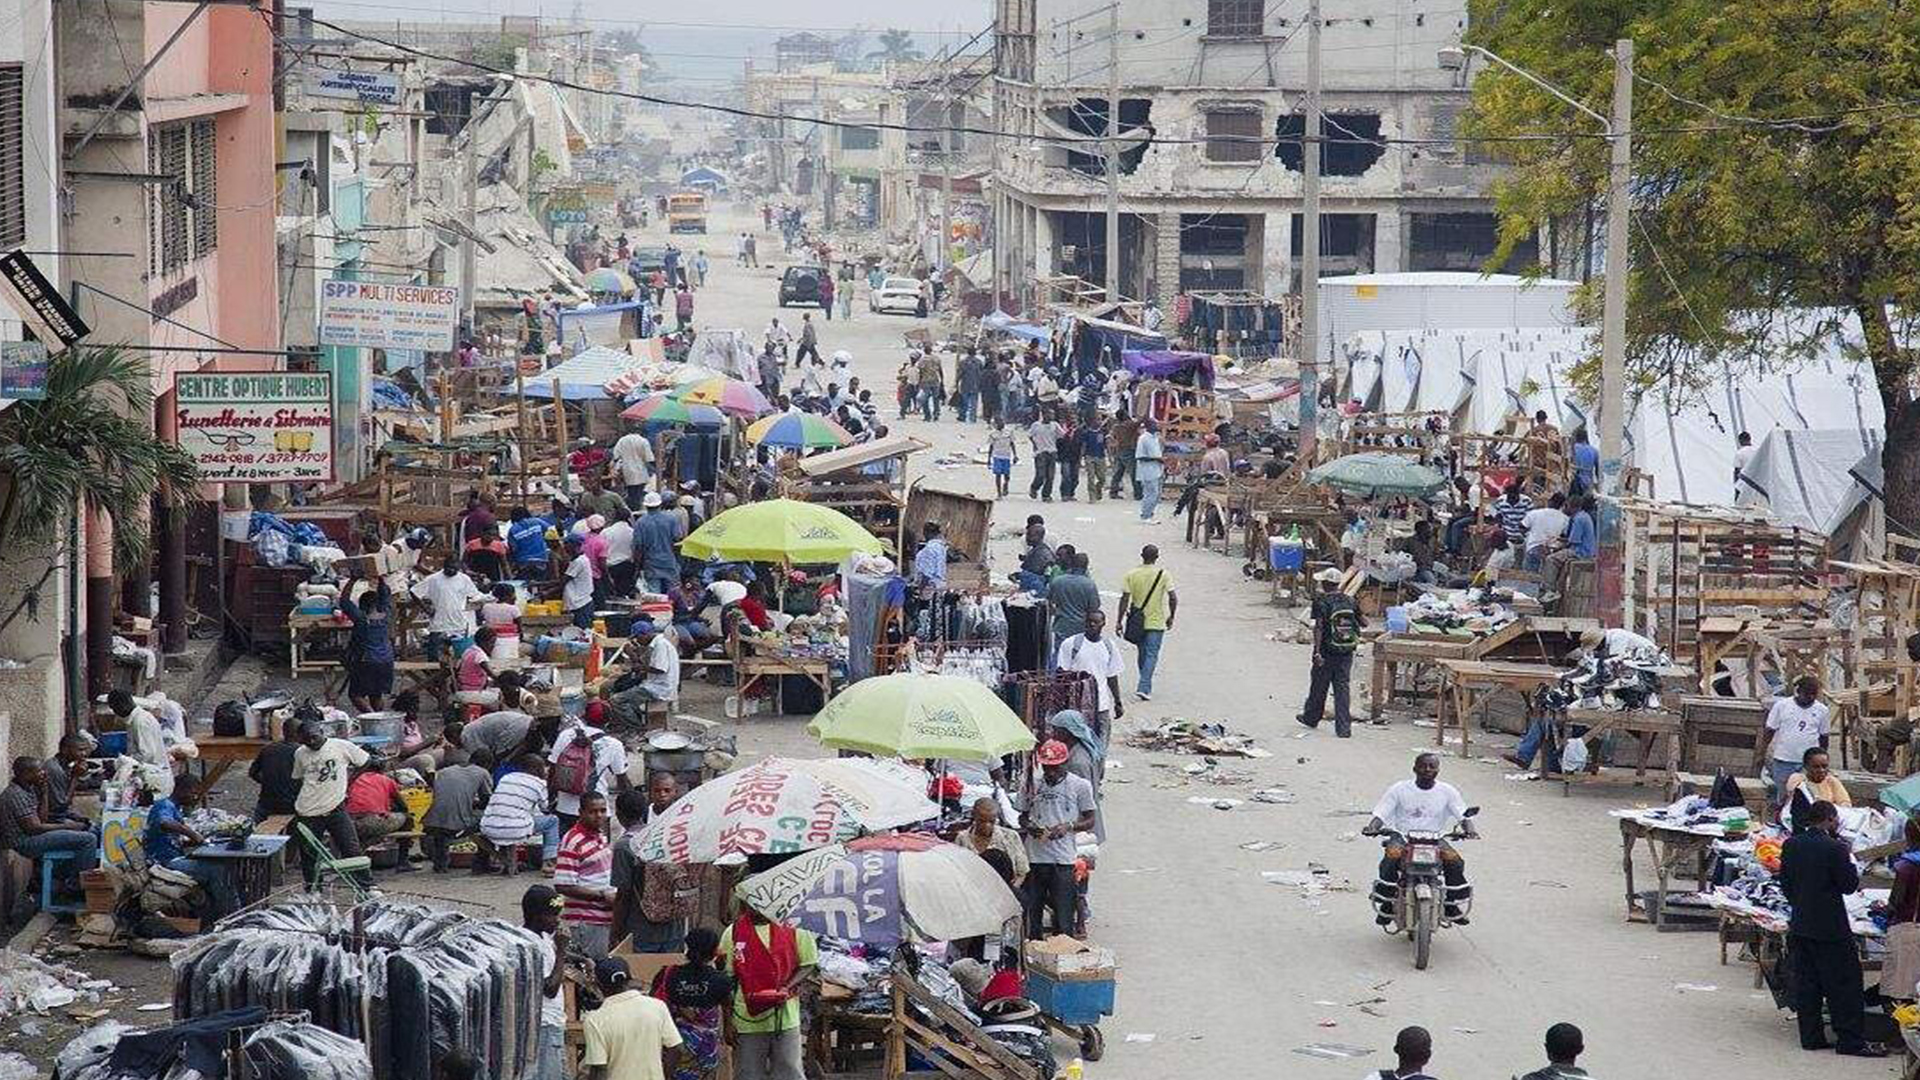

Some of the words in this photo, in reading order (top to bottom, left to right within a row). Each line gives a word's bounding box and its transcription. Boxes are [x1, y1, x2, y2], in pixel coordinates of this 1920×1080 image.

[325, 282, 357, 298] SPP
[359, 284, 395, 300] MULTI
[396, 287, 454, 305] SERVICES
[178, 376, 229, 398] CENTRE
[232, 377, 284, 399] OPTIQUE
[285, 377, 329, 397] HUBERT
[178, 408, 262, 428] Lunetterie
[1798, 720, 1807, 732] 9
